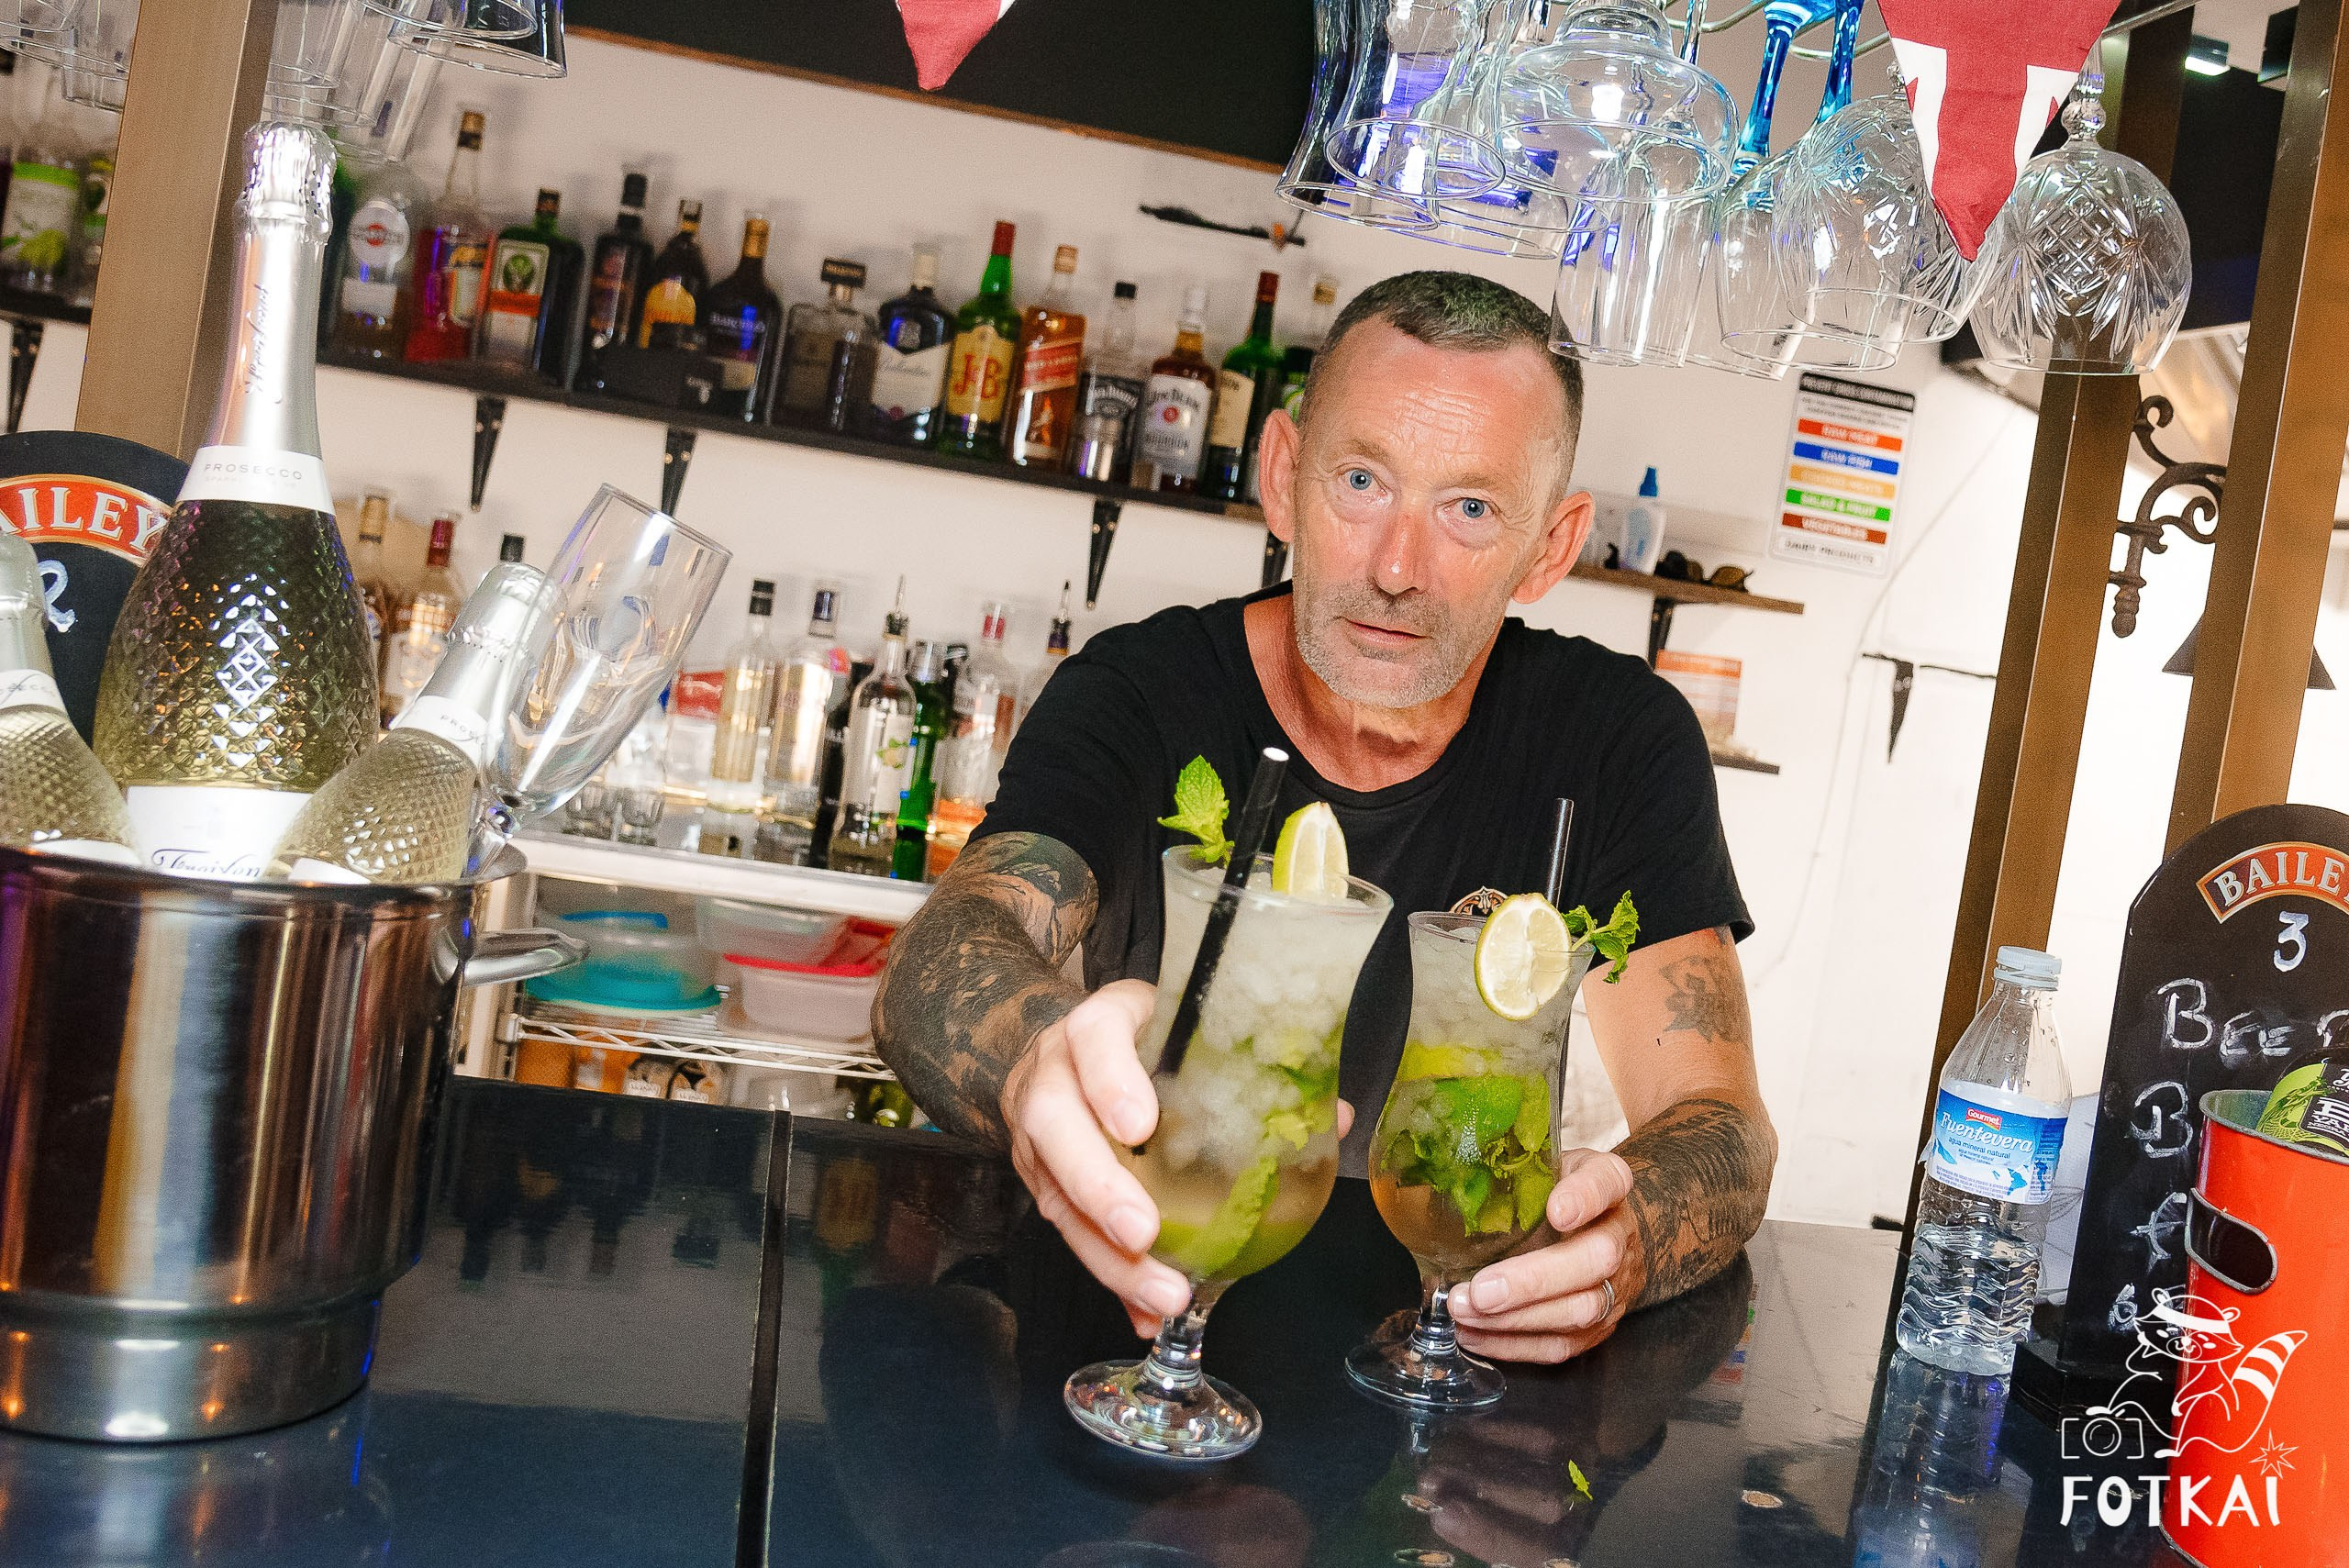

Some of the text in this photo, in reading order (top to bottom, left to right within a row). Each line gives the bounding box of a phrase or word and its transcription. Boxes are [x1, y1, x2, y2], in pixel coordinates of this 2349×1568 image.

[204, 463, 303, 480] PROSECCO
[2214, 851, 2349, 907] BAILE
[2274, 910, 2310, 973] 3
[1940, 1111, 2034, 1153] Fuentevera
[1966, 1108, 2001, 1127] Gourmet
[1948, 1137, 2011, 1159] agua mineral natural
